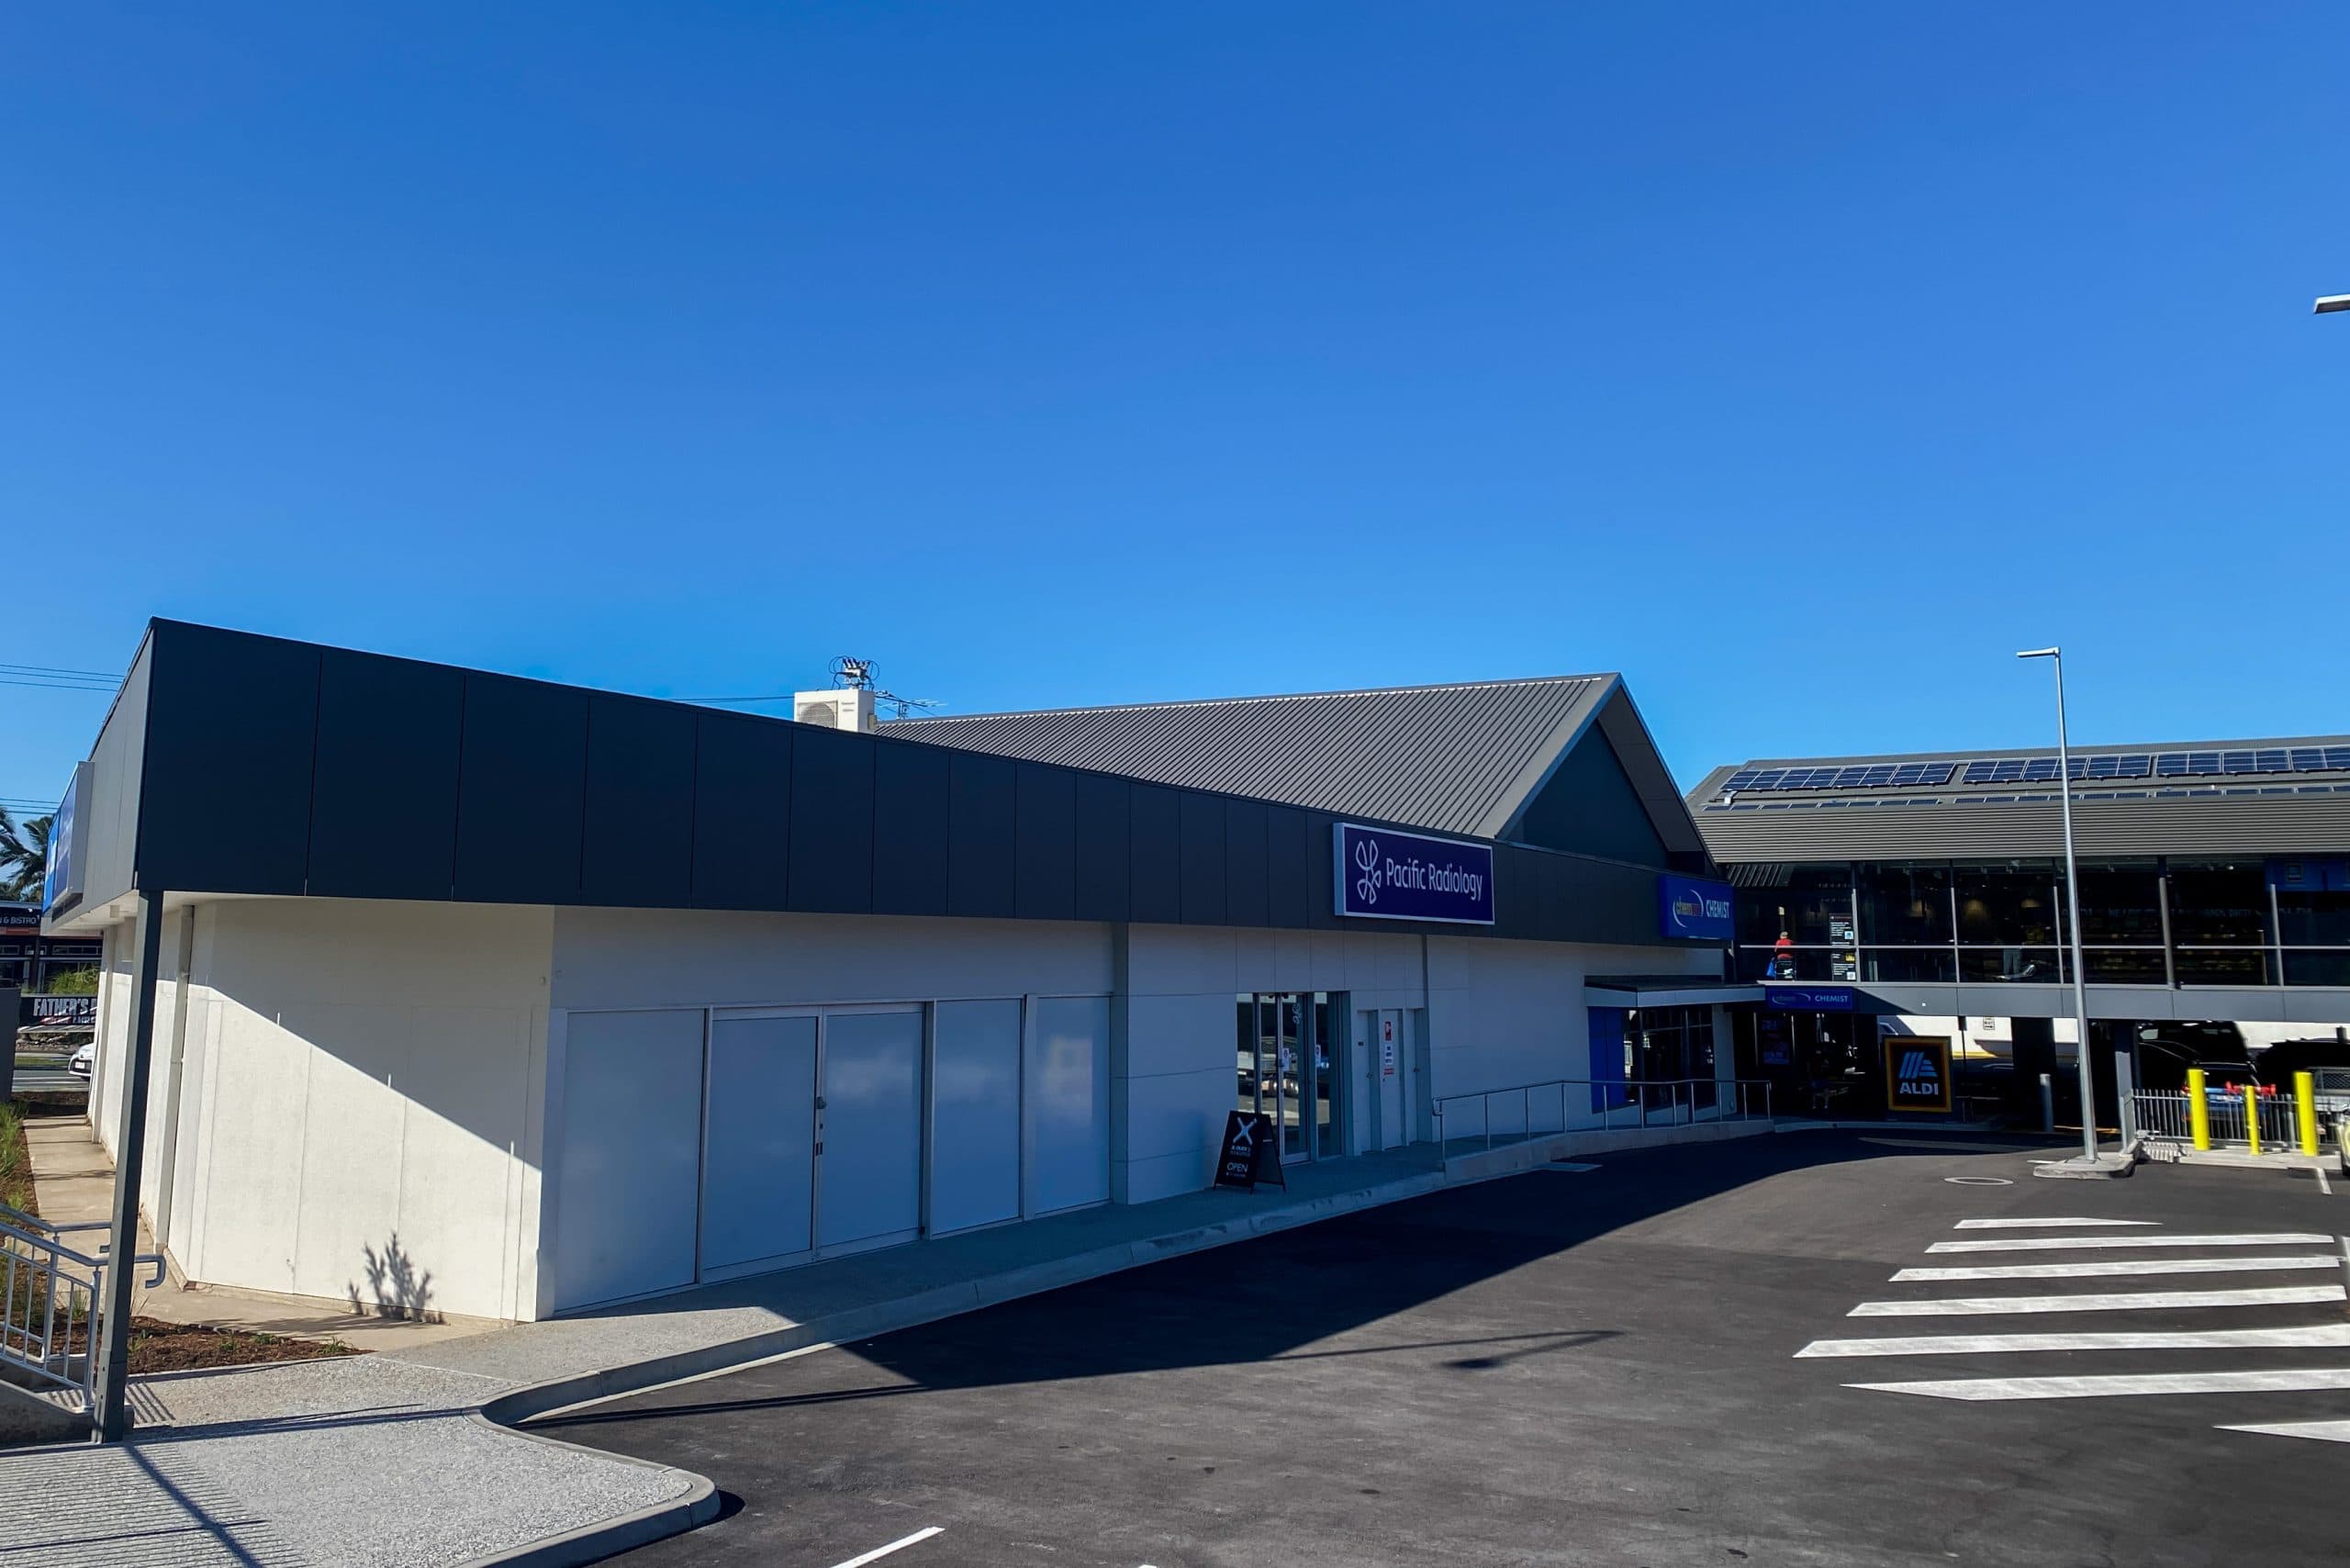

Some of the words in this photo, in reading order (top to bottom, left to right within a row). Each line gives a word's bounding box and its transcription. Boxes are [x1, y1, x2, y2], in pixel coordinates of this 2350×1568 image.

[1386, 857, 1427, 890] Pacific
[1428, 862, 1483, 902] Radiology
[1706, 899, 1730, 919] CHEMIST
[10, 916, 37, 924] BISTRO
[1814, 994, 1849, 1003] CHEMIST
[33, 998, 89, 1016] FATHER'S
[1899, 1081, 1939, 1095] ALDI
[1226, 1161, 1248, 1173] OPEN
